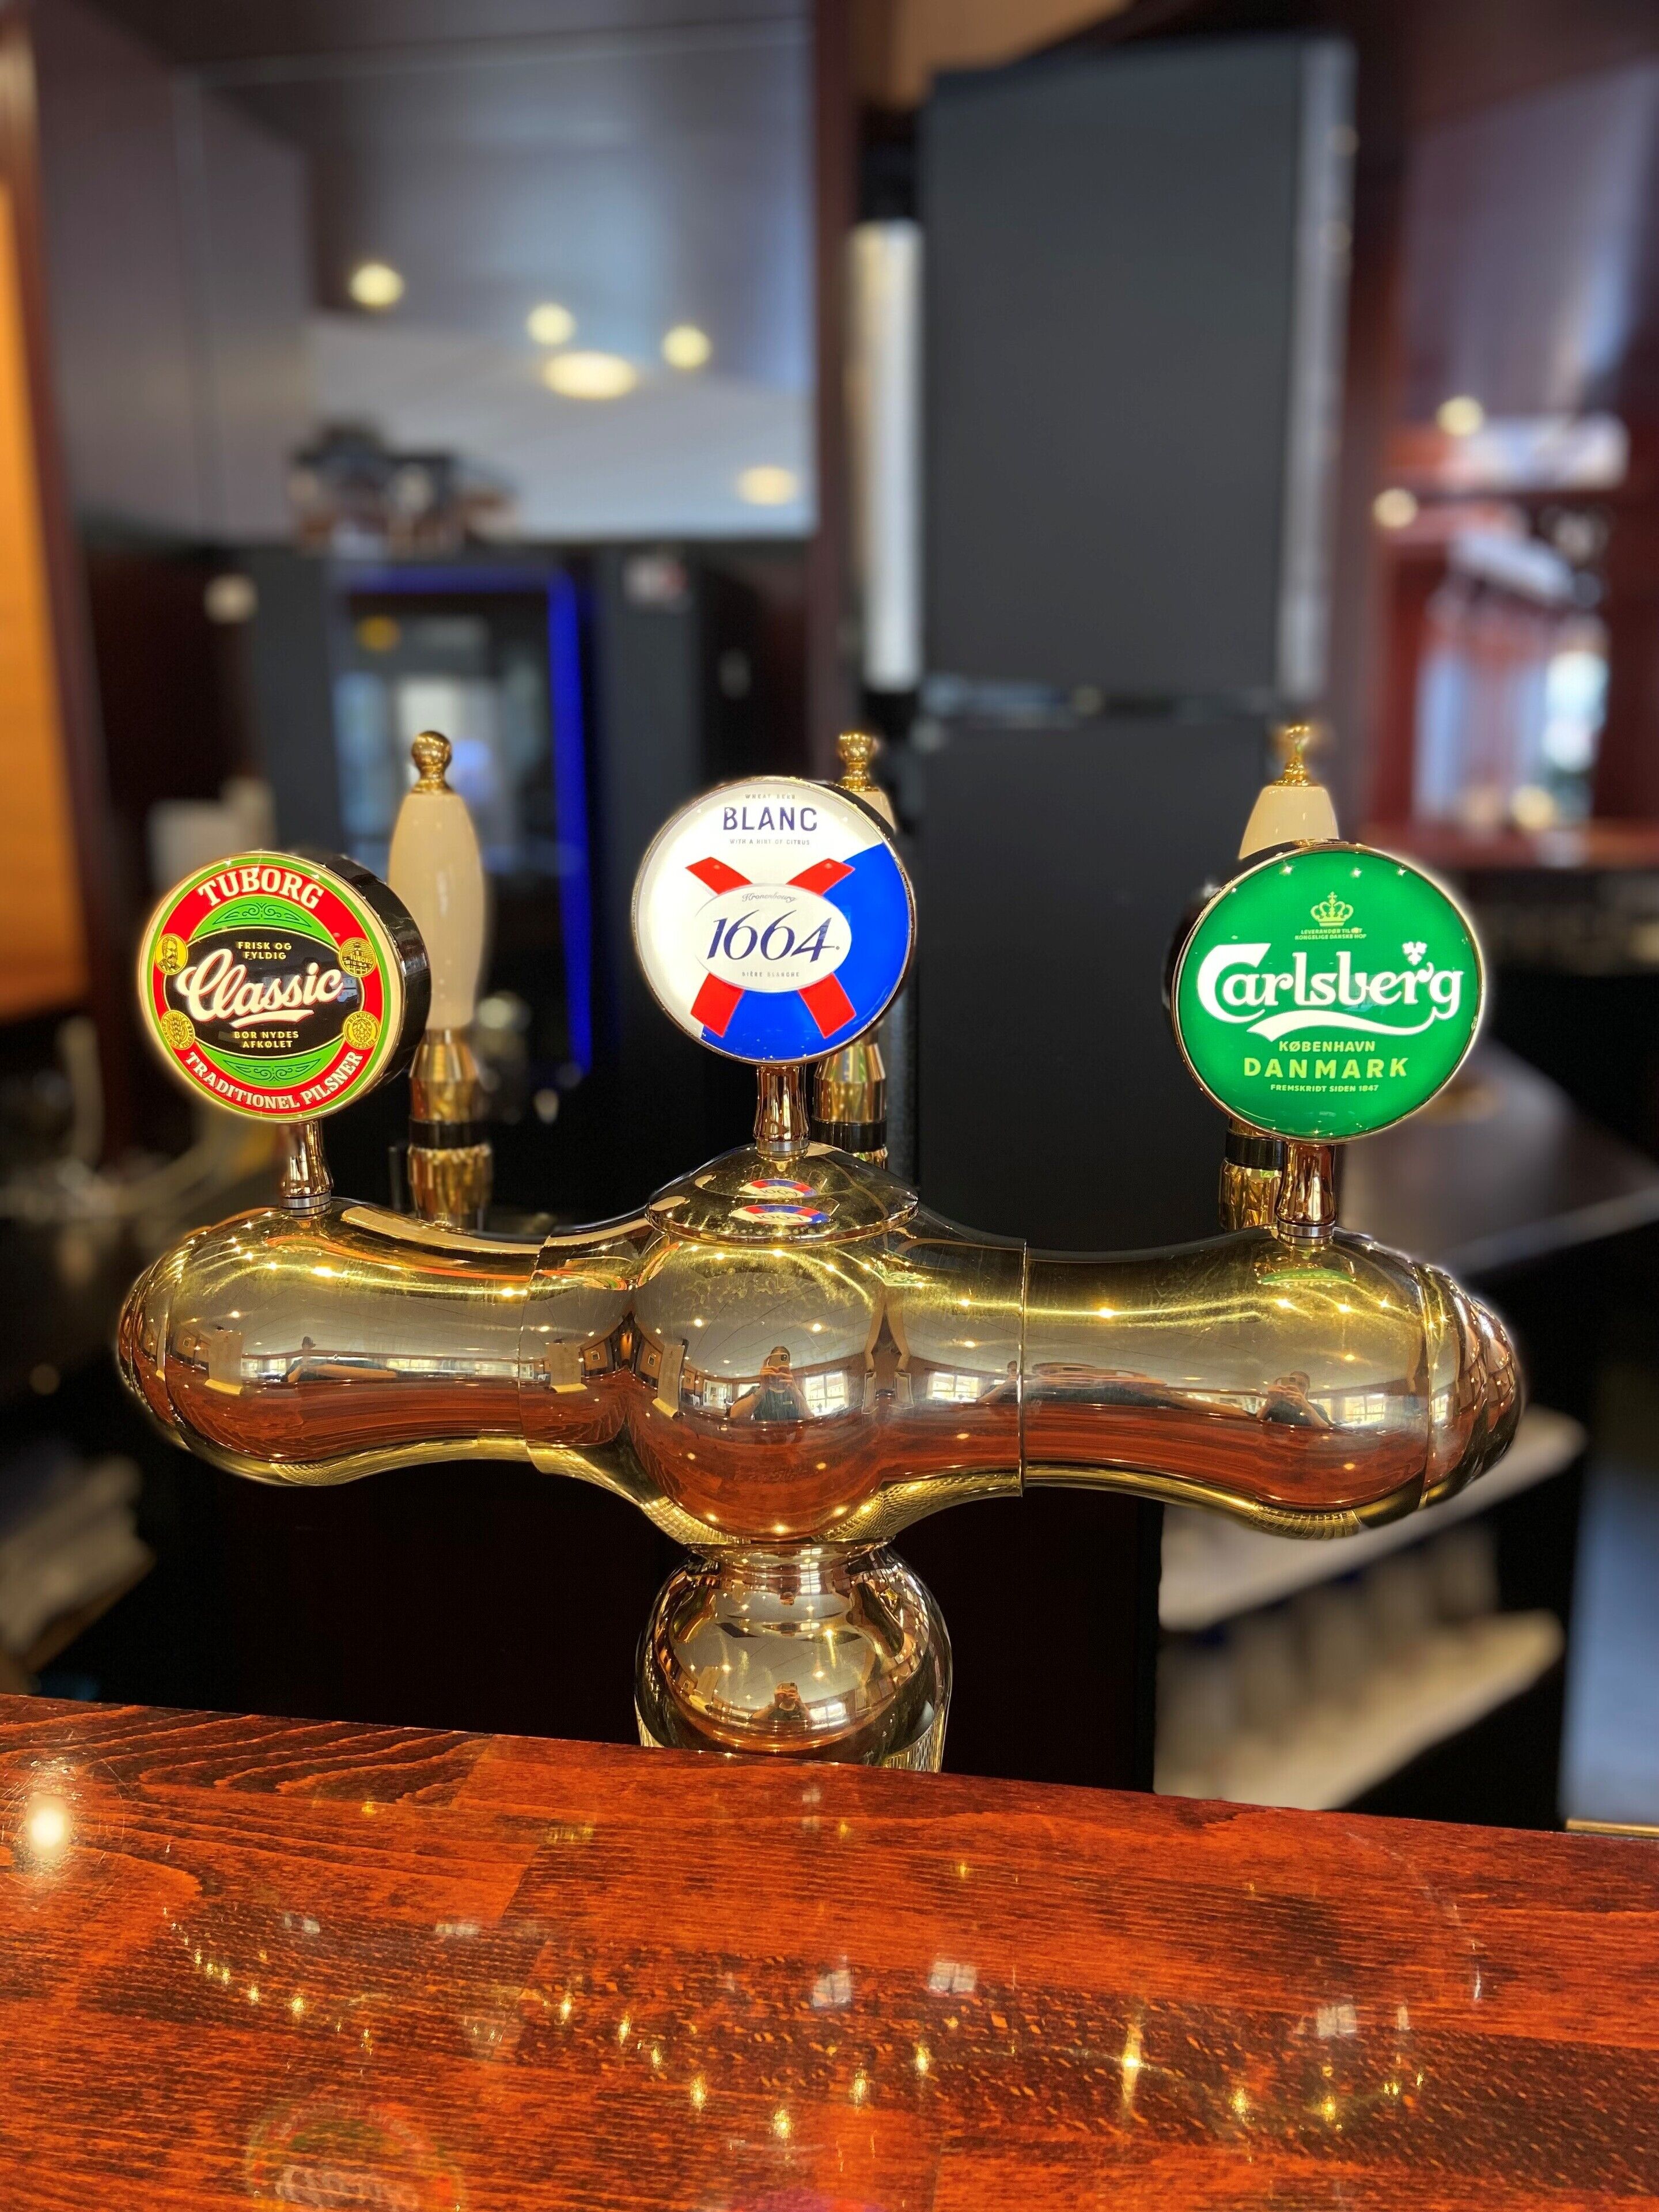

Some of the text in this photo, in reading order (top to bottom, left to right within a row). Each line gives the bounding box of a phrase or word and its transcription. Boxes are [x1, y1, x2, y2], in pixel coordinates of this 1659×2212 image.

[723, 806, 817, 831] BLANC
[198, 868, 325, 909] TUBORG
[238, 942, 292, 950] FRISK OG
[707, 909, 835, 963] 1664
[244, 951, 287, 960] FYLDIG
[176, 948, 344, 1022] Classic
[1197, 941, 1464, 1031] Carlsberg
[234, 1031, 300, 1039] BØR NYDES
[243, 1040, 293, 1048] AFKØLET
[1278, 1040, 1376, 1052] KØBENHAVN
[1244, 1057, 1408, 1079] DANMARK
[185, 1051, 363, 1109] TRADITIONEL PILSNER
[1270, 1084, 1327, 1093] FREMSKRIDT
